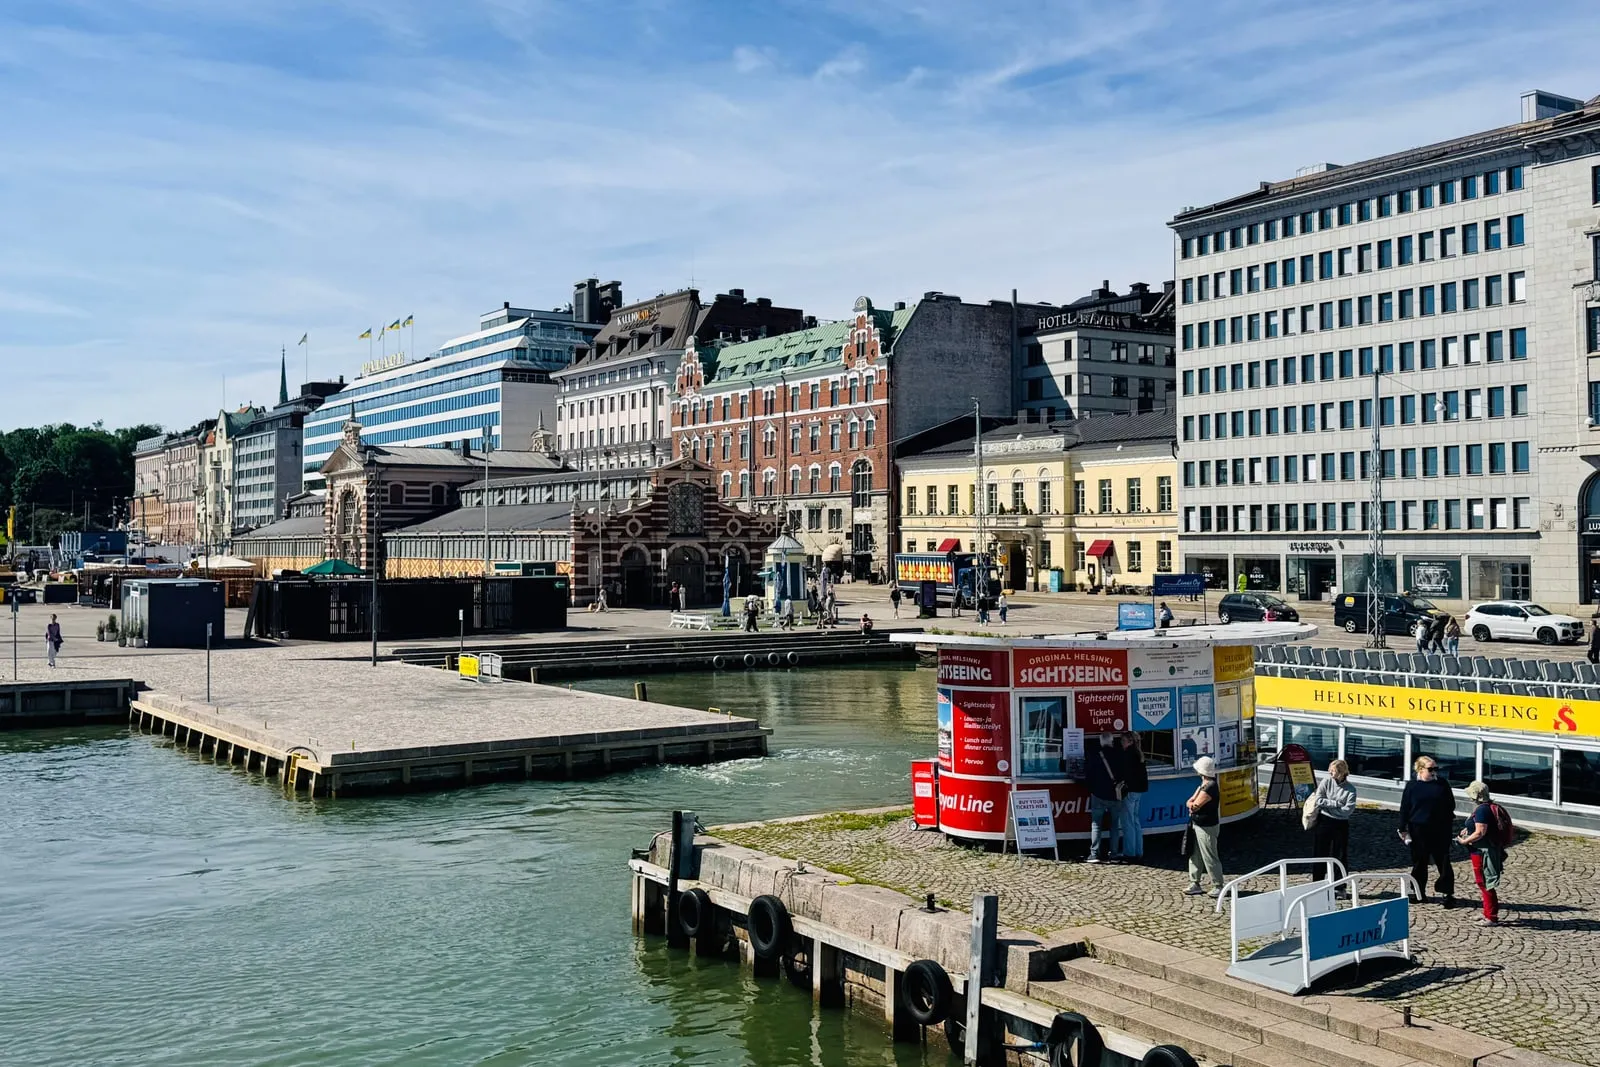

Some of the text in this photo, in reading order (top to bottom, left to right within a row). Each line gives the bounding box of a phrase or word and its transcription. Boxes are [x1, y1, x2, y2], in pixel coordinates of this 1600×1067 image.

[1038, 313, 1075, 329] HOTEL
[1029, 653, 1113, 665] ORIGINAL HELSINKI
[1020, 665, 1123, 683] SIGHTSEEING
[963, 701, 995, 710] Sightseeing
[1077, 693, 1125, 704] Sightseeing
[1313, 689, 1396, 709] HELSINKI
[1408, 697, 1539, 721] SIGHTSEEING
[1089, 709, 1115, 717] Tickets
[1092, 717, 1112, 726] Liput
[964, 736, 980, 744] Lunch
[960, 794, 994, 813] Line
[1146, 804, 1189, 822] JT-LI
[1338, 927, 1381, 948] JT-LINE
